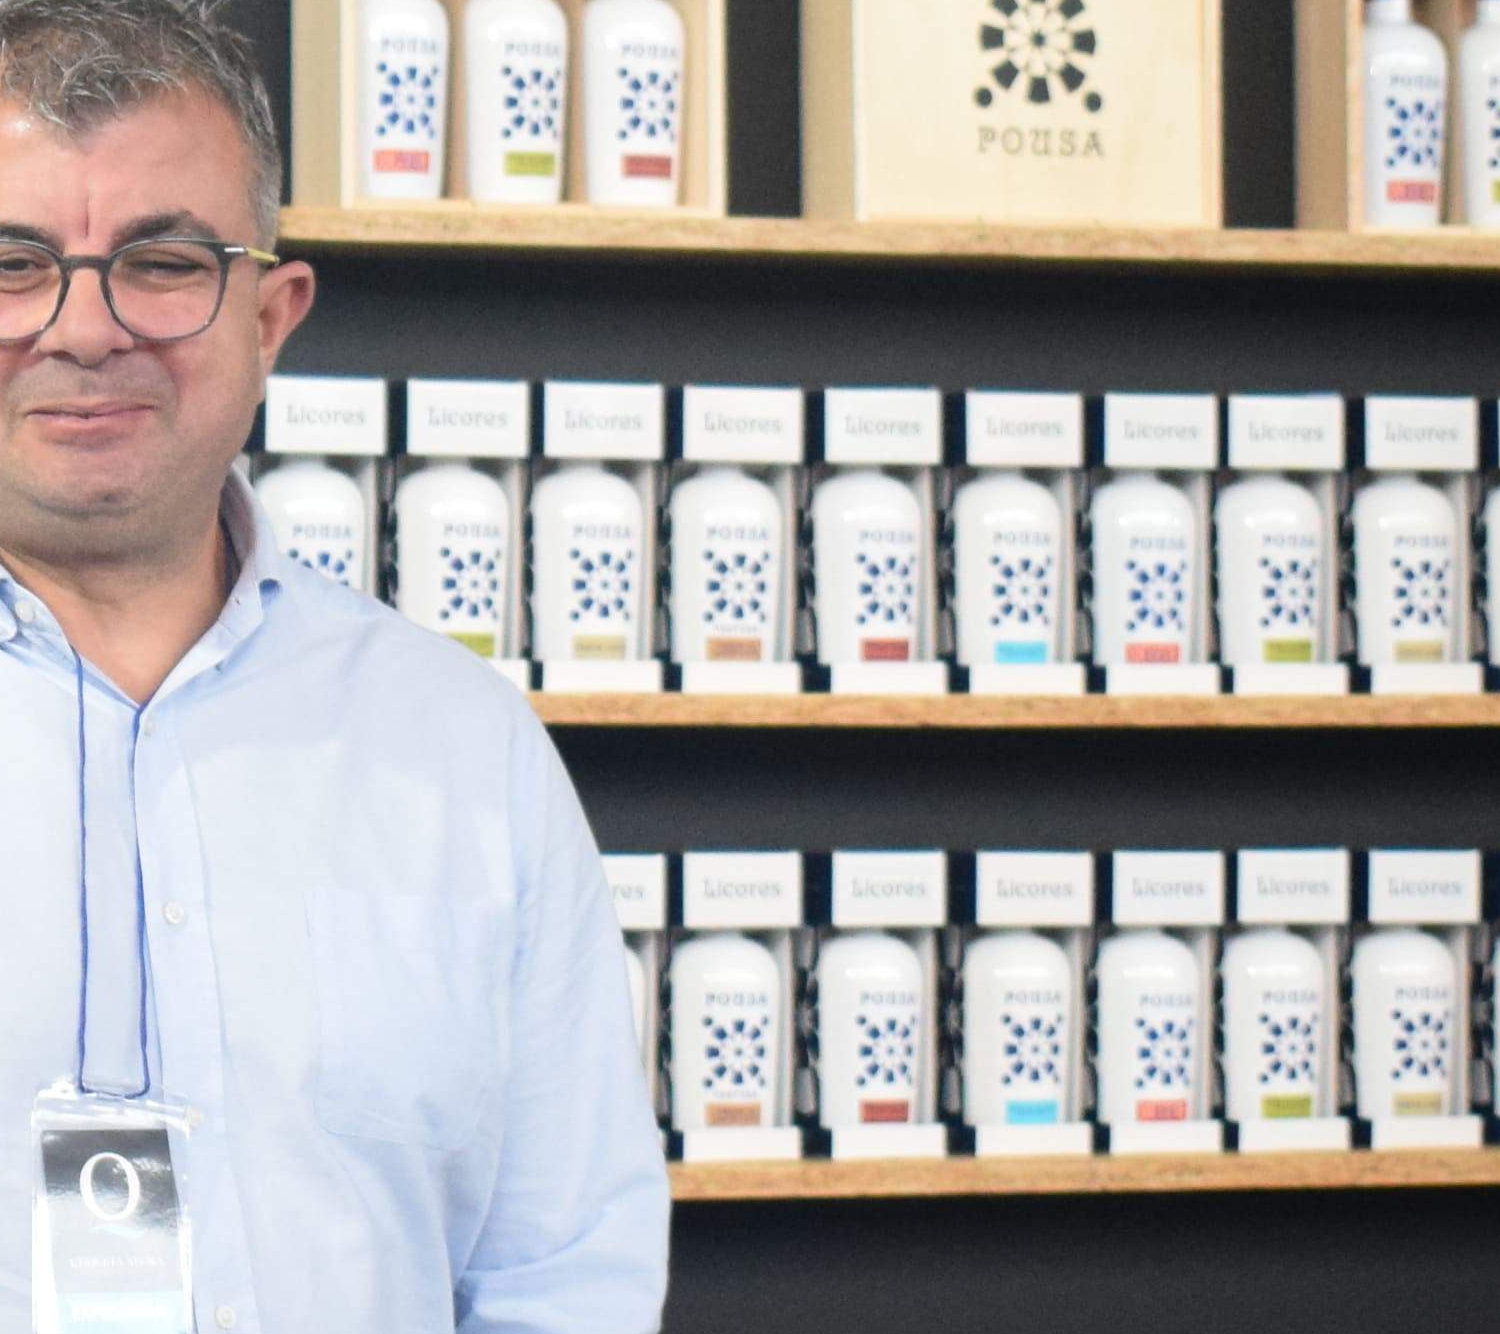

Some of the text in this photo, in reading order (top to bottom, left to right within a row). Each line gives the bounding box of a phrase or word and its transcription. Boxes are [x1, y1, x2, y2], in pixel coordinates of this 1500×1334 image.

[976, 127, 1106, 160] POUSA
[286, 402, 367, 426] Licores
[428, 405, 508, 428] Licores
[564, 408, 644, 431] Licores
[703, 411, 783, 434] Licores
[844, 414, 922, 436] Licores
[986, 416, 1063, 438] Licores
[1123, 419, 1198, 441] Licores
[1248, 421, 1325, 443] Licores
[1385, 421, 1459, 443] Licores
[703, 878, 781, 899] Licores
[852, 877, 926, 898] Licores
[997, 878, 1073, 899] Licores
[1132, 877, 1206, 897] Licores
[1257, 875, 1330, 896] Licores
[1388, 875, 1461, 896] Licores
